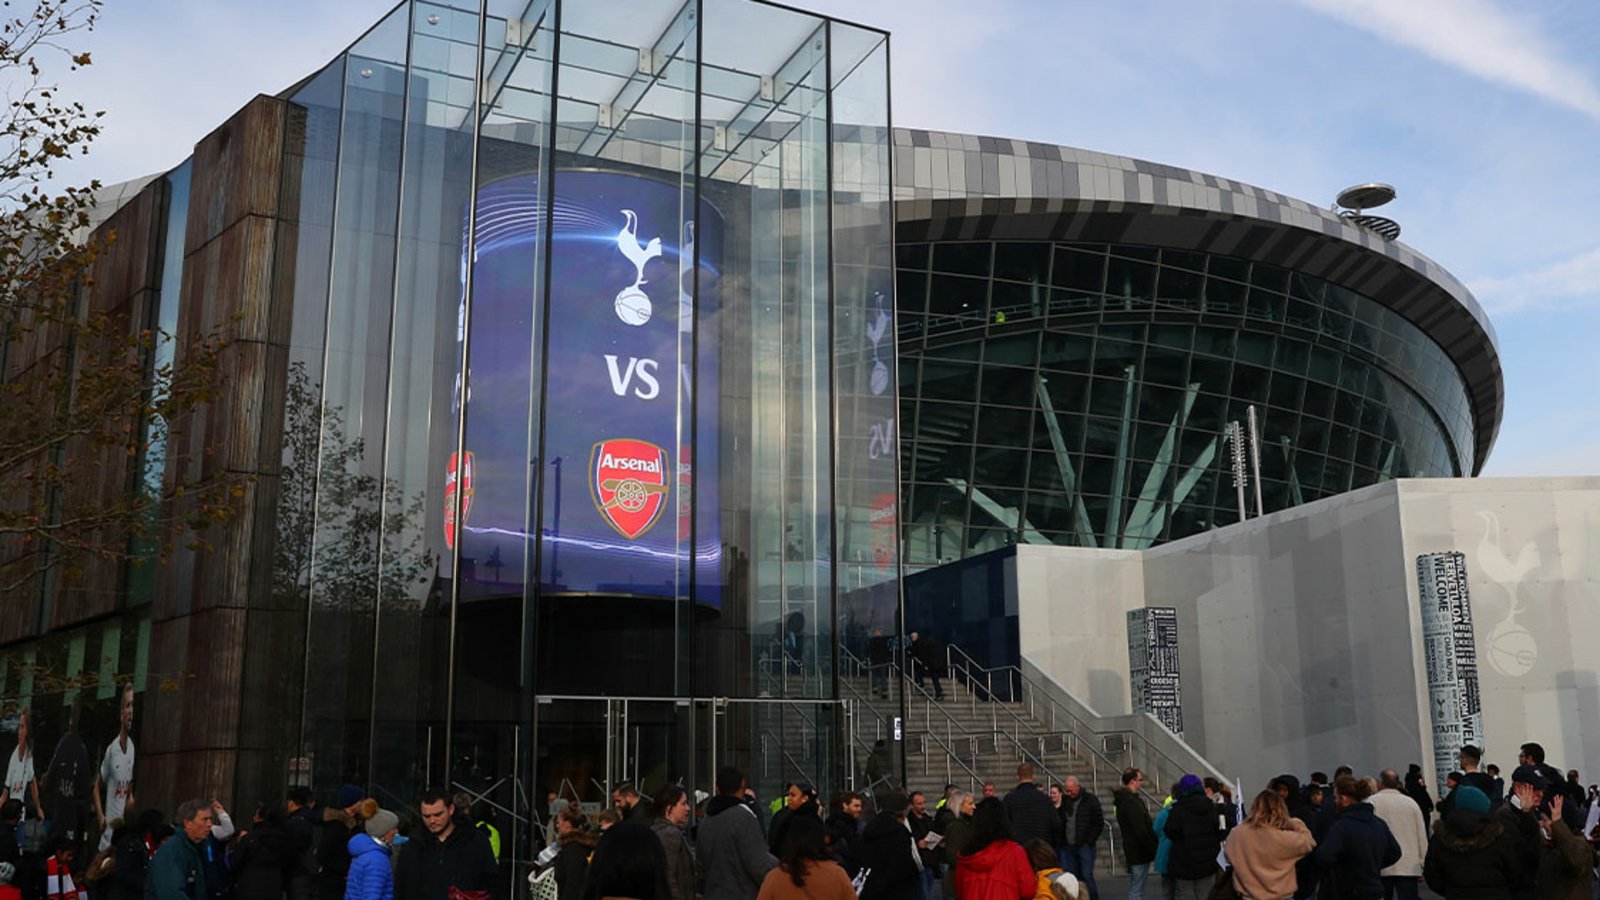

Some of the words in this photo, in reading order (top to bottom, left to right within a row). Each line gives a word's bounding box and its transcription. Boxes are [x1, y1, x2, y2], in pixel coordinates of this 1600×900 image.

[604, 354, 660, 400] VS
[601, 453, 661, 473] Arsenal
[1434, 556, 1449, 613] WELCOME
[1445, 556, 1462, 624] TERVETULOA
[1456, 555, 1470, 624] WILLKOMMEN
[1457, 678, 1470, 716] WELKOM
[1462, 716, 1475, 745] WEL
